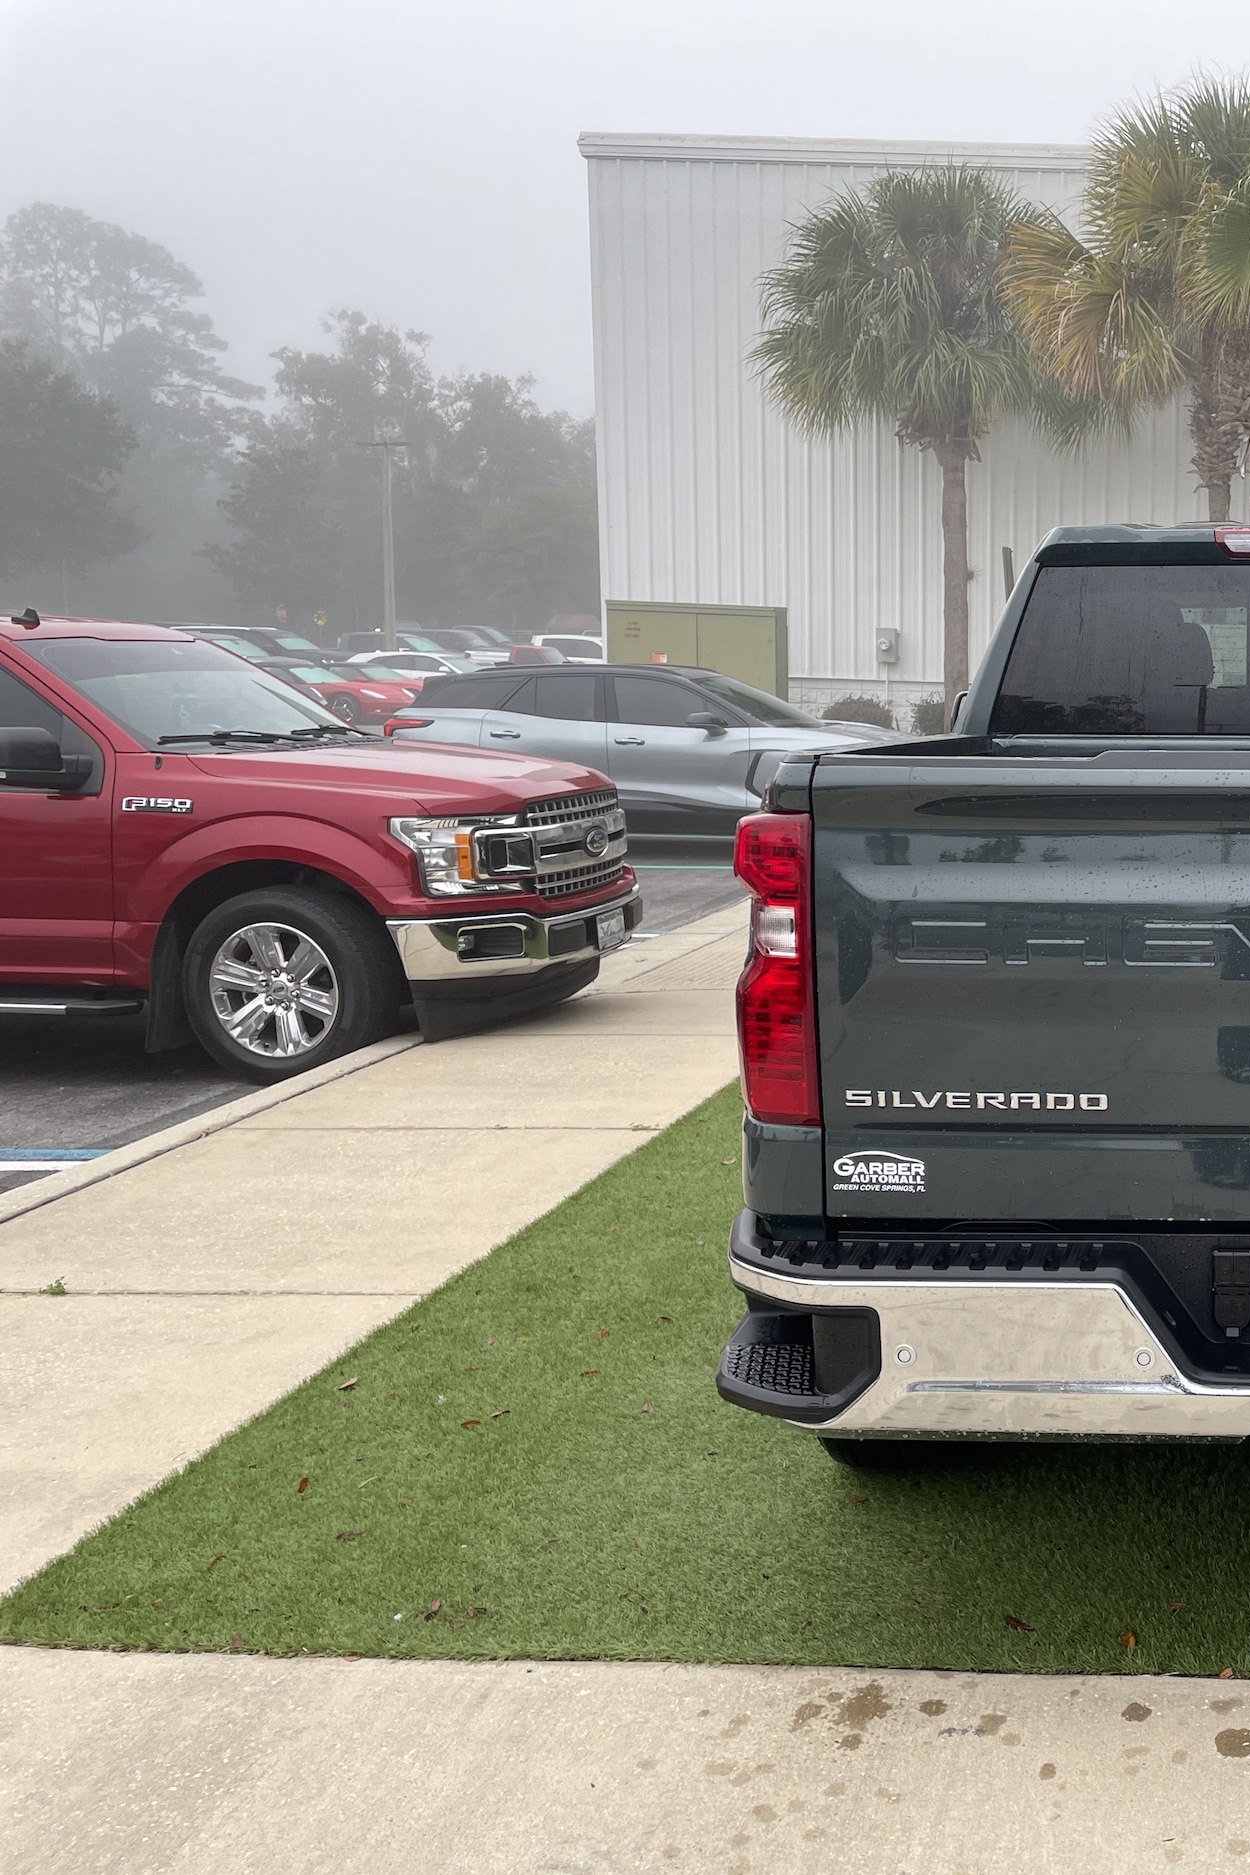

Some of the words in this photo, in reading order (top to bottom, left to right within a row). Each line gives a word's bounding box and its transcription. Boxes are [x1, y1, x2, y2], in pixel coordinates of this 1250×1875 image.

[122, 797, 192, 811] F150
[845, 1089, 1108, 1111] SILVERADO
[833, 1158, 925, 1177] GARBER
[850, 1174, 925, 1184] AUTOMALL
[833, 1183, 859, 1191] GREEN
[881, 1184, 915, 1193] SPRINGS,
